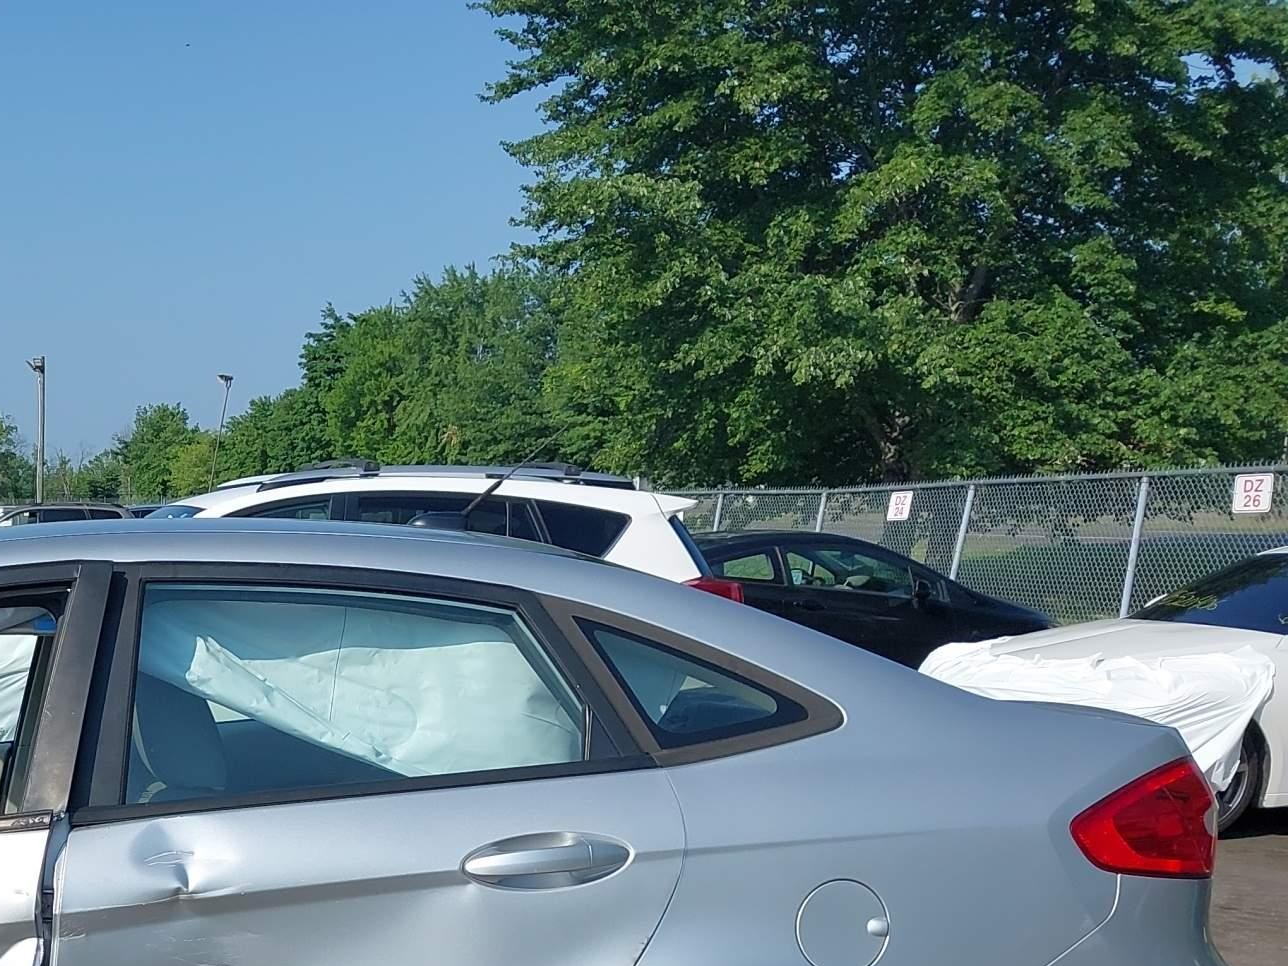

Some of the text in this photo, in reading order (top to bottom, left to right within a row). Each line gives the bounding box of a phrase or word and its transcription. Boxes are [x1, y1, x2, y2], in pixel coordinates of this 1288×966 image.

[1243, 479, 1265, 493] DZ
[894, 495, 908, 506] DZ
[1243, 494, 1262, 508] 26
[893, 506, 904, 517] 24
